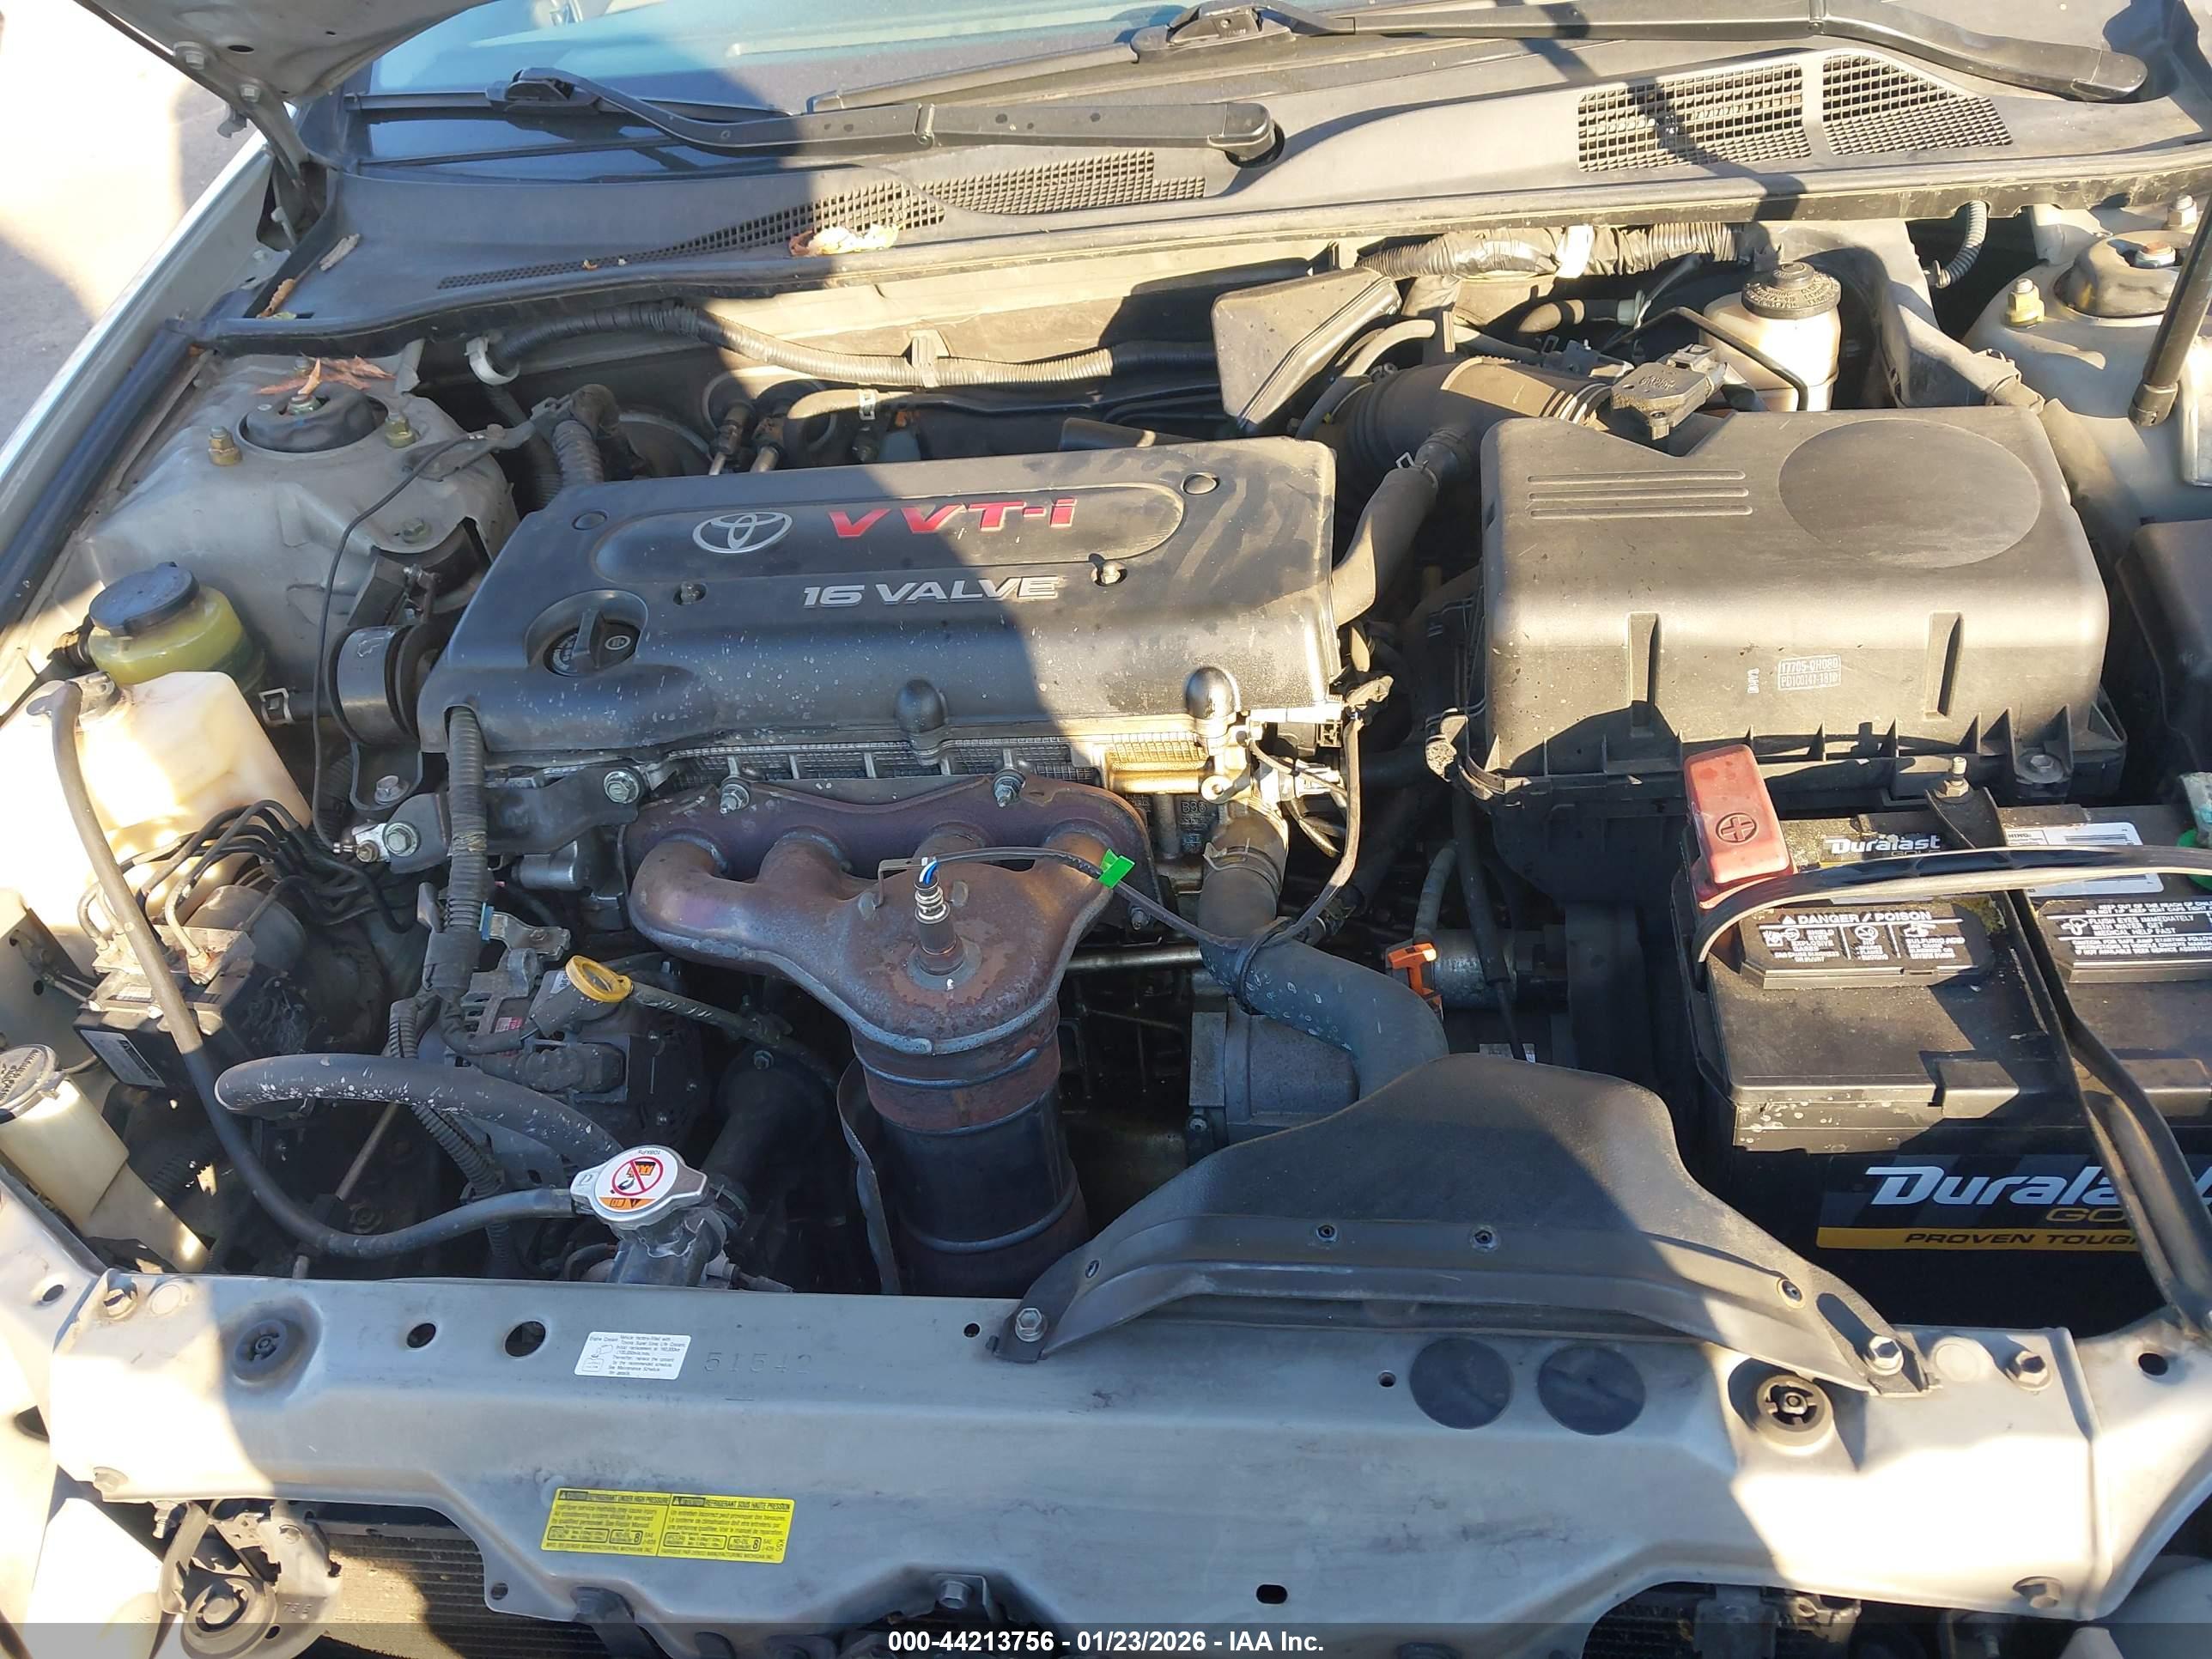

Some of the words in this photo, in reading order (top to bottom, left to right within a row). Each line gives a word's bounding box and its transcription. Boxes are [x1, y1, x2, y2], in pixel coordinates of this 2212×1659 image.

[829, 499, 1077, 538] VVT-i
[804, 585, 865, 608] 16
[875, 575, 1059, 605] VALVE
[1824, 835, 1941, 854] Duralast
[1797, 914, 1860, 925] DANGER
[1875, 911, 1932, 921] POISON
[2140, 915, 2194, 923] IMMEDIATELY
[2045, 1208, 2126, 1223] GO
[1904, 1234, 2035, 1245] PROVEN
[2047, 1235, 2137, 1245] TOUG
